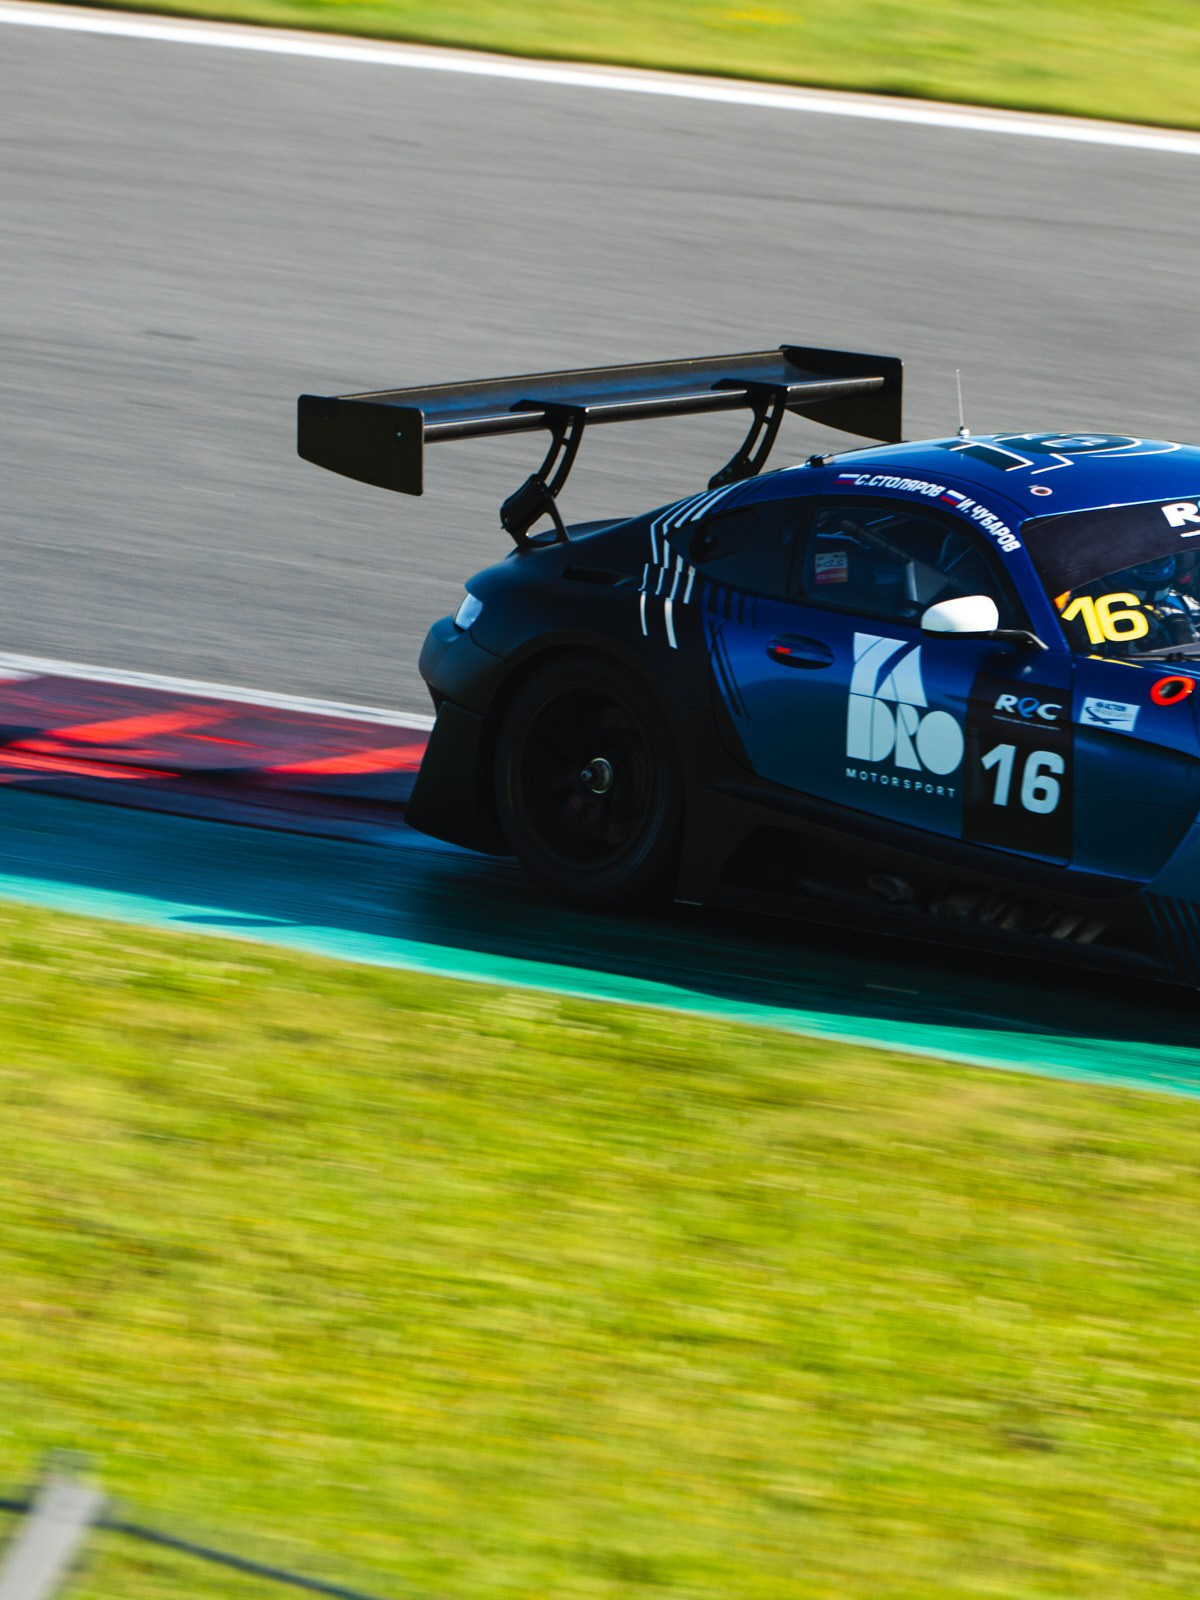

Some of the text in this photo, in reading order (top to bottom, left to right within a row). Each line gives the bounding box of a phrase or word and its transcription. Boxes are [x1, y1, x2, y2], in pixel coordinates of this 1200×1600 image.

[854, 474, 946, 497] С.СТОЛЯРОВ
[955, 498, 1022, 553] И.ЧУБАРОВ
[1061, 592, 1149, 644] 16
[846, 768, 956, 798] MOTORSPORT
[981, 743, 1065, 814] 16
